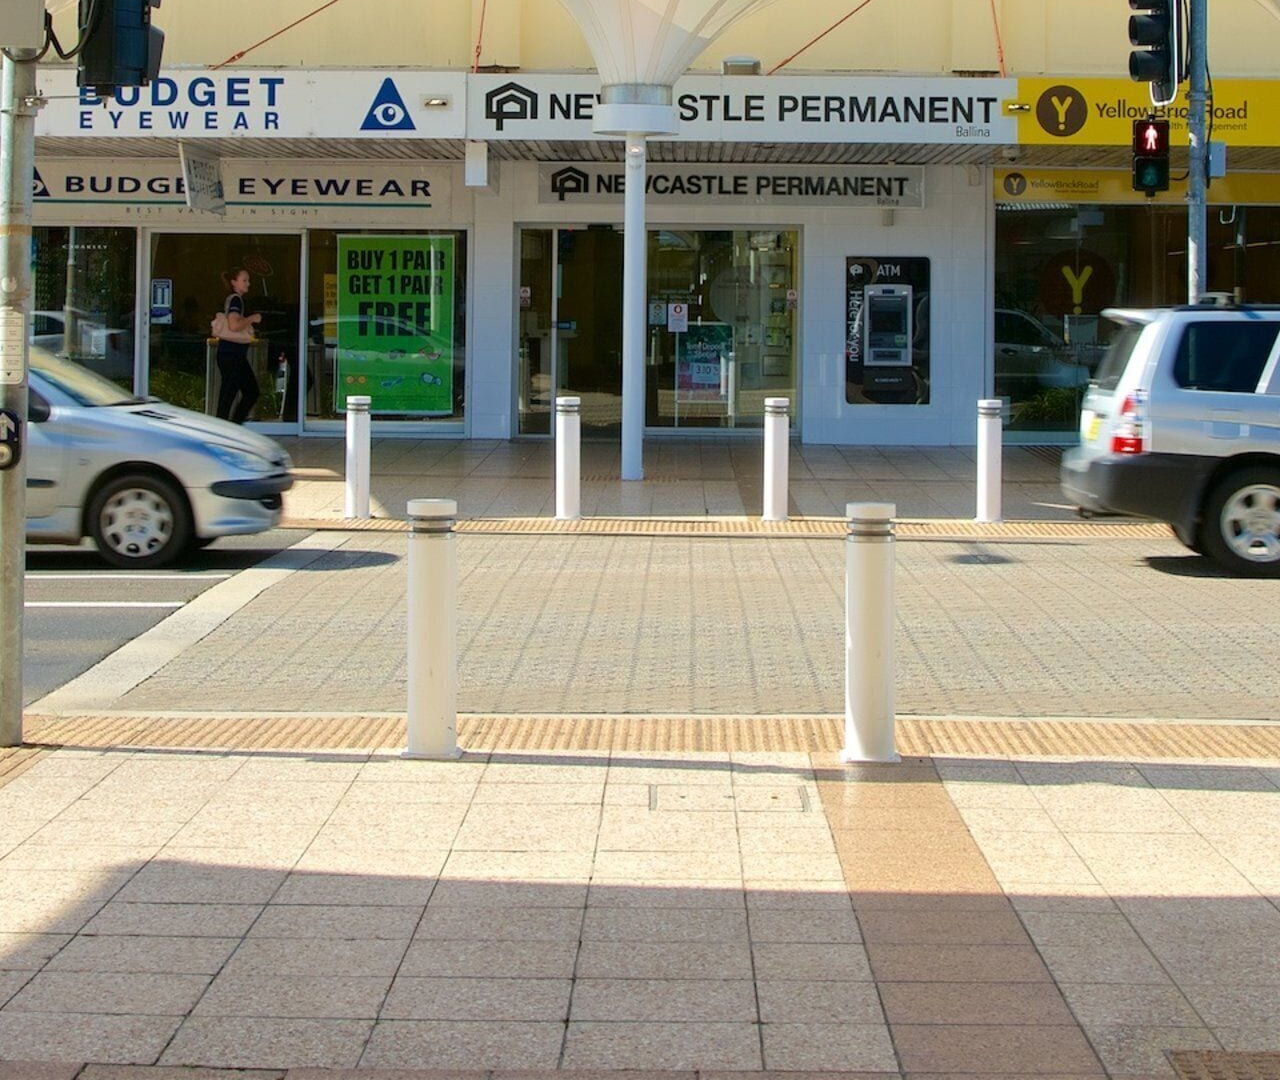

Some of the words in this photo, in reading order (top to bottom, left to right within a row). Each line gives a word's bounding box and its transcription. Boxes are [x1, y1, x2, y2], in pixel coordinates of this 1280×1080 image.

[79, 77, 285, 107] BUDGET
[550, 94, 765, 121] NESTLE
[778, 96, 998, 123] PERMANENT
[79, 110, 280, 130] EYEWEAR
[956, 126, 991, 138] Ballina
[65, 175, 186, 194] BUDGE
[238, 177, 432, 197] EYEWEAR
[596, 175, 748, 195] NECASTLE
[756, 176, 909, 196] PERMANENT
[126, 207, 163, 215] BEST
[347, 250, 385, 270] BUY
[388, 250, 398, 270] 1
[403, 250, 445, 270] PAIR
[876, 264, 901, 277] ATM
[349, 274, 382, 295] GET
[387, 274, 396, 295] 1
[401, 274, 443, 295] PAIR
[849, 290, 863, 321] Here
[358, 301, 432, 336] FREE
